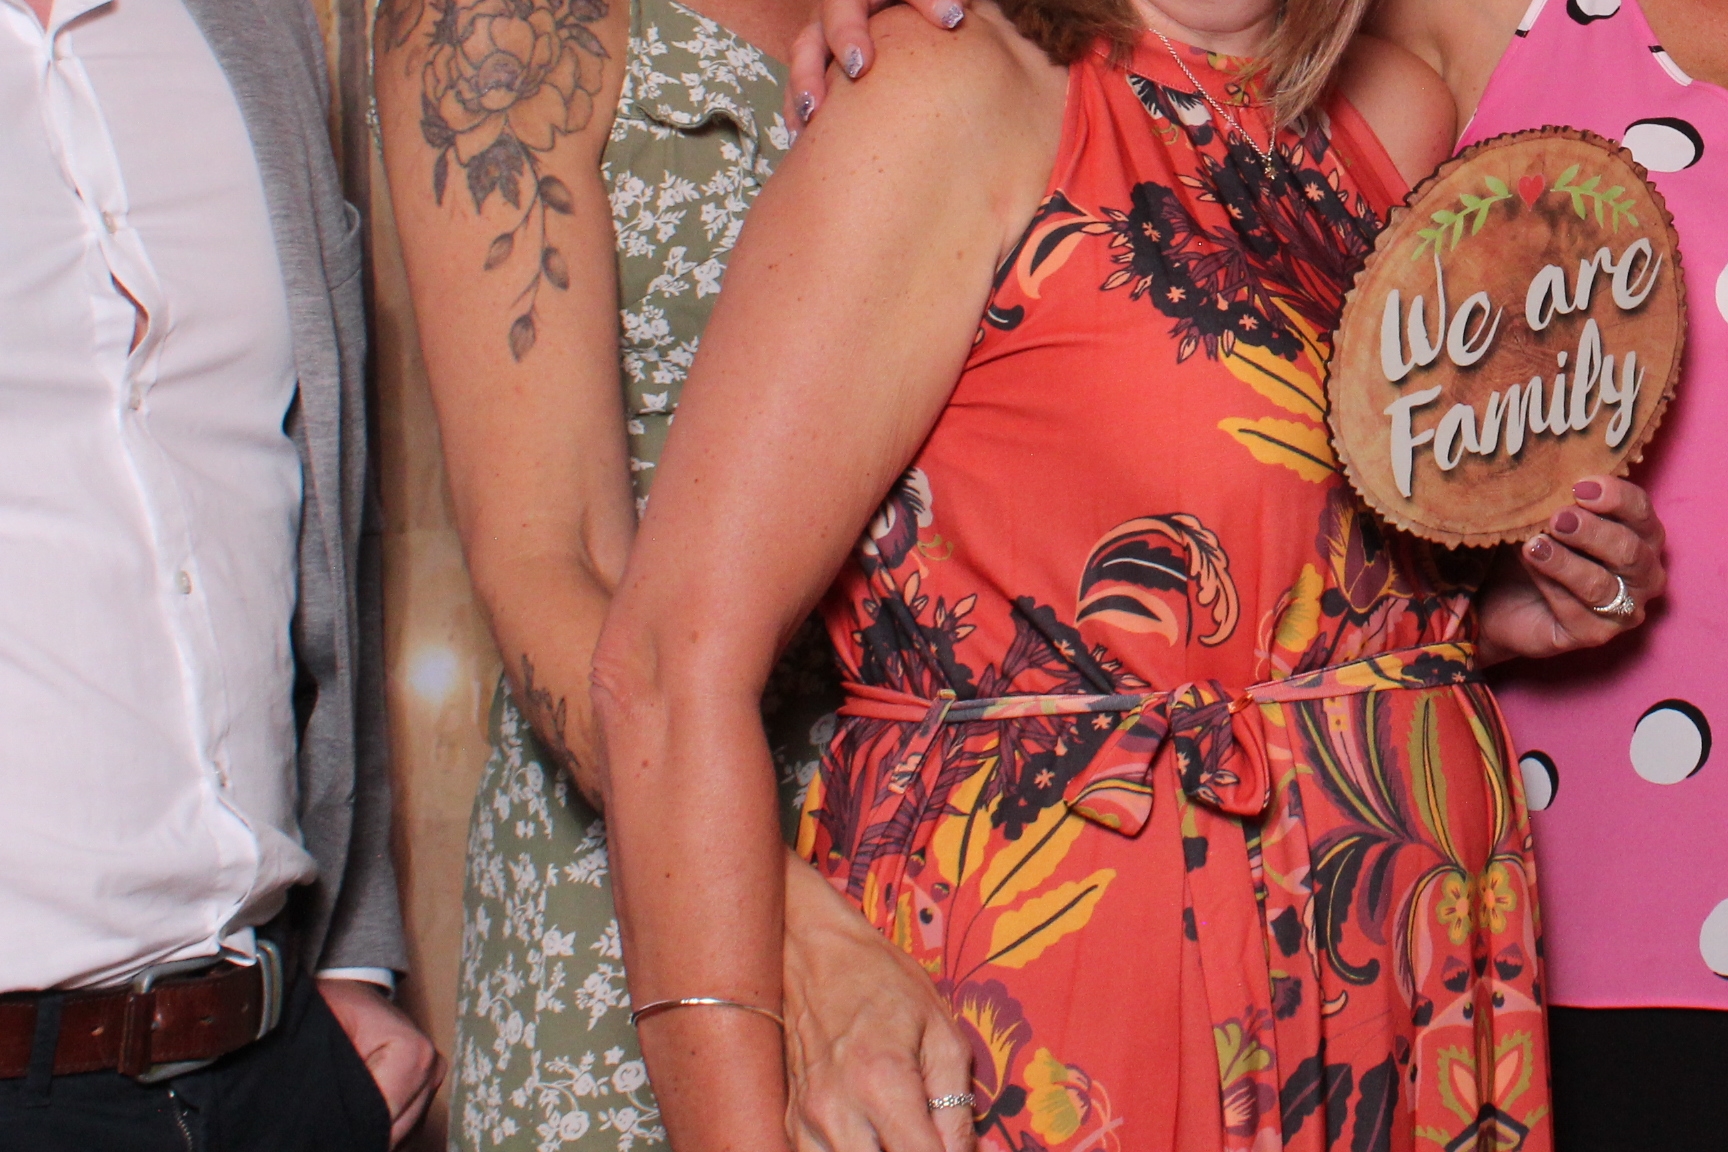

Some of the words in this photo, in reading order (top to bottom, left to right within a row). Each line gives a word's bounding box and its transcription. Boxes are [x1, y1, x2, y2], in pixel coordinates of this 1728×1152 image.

[1380, 253, 1503, 382] We
[1525, 237, 1663, 331] are
[1384, 318, 1645, 498] Family
